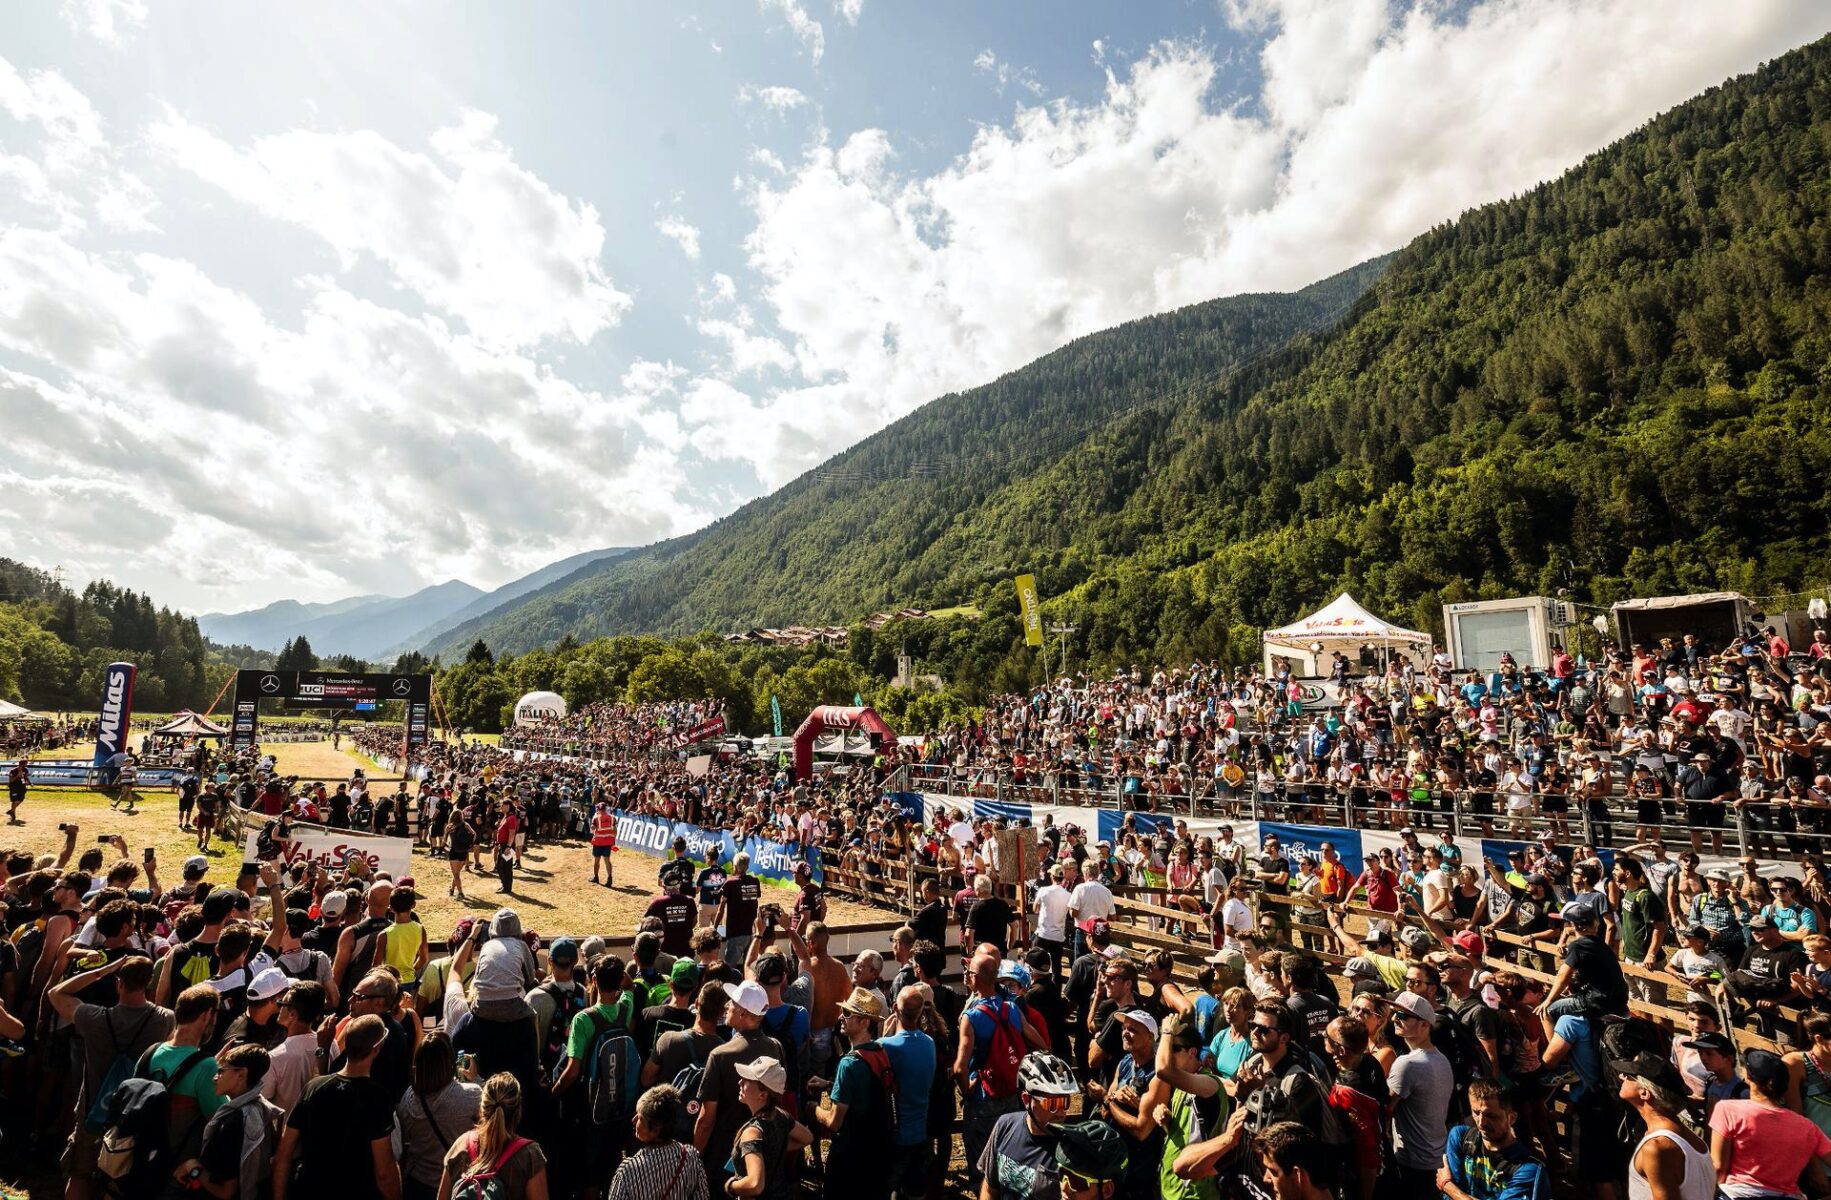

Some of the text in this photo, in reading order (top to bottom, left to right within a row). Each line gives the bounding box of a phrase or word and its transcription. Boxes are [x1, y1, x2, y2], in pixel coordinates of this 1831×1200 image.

[304, 686, 323, 694] UCI
[100, 671, 125, 752] Mitas
[822, 709, 850, 727] ITAS
[615, 815, 669, 850] MANO
[754, 844, 796, 872] TRENTIN
[1280, 843, 1341, 863] TRENTIO
[609, 1053, 617, 1102] HEAD
